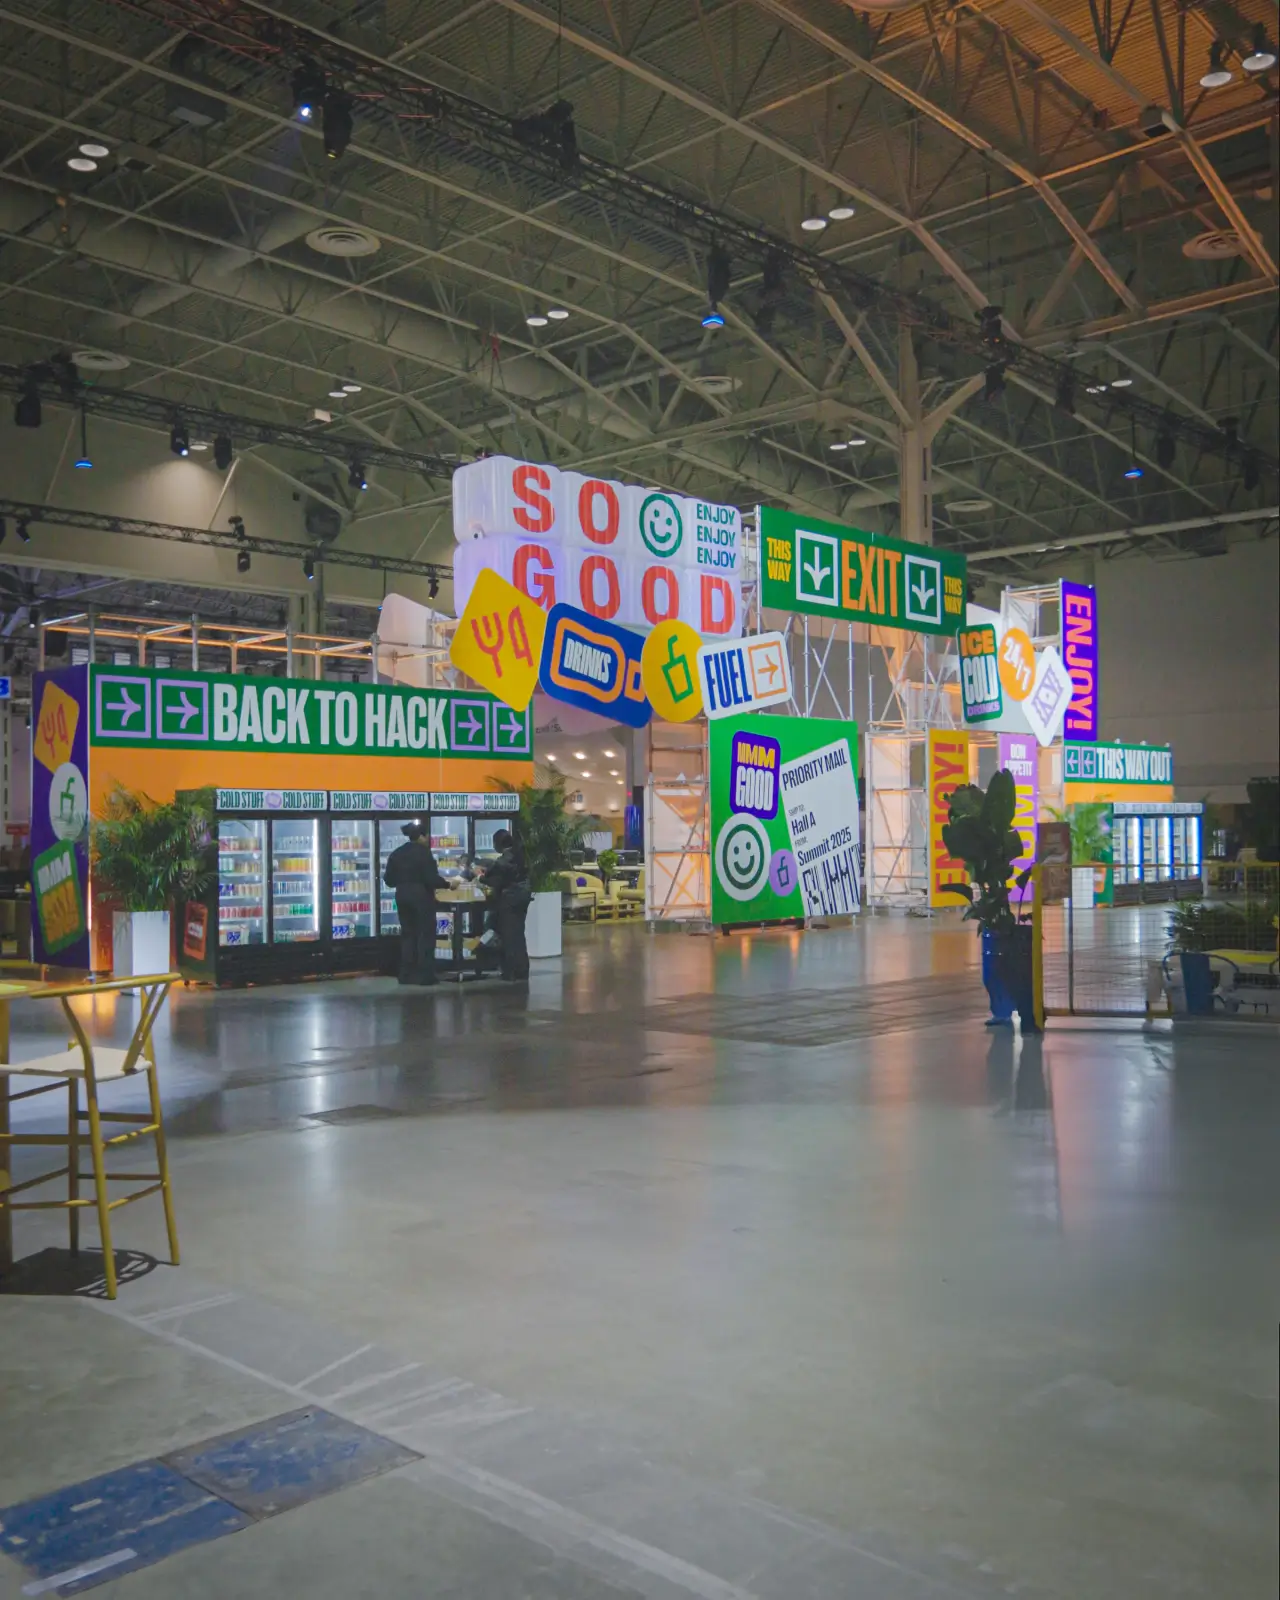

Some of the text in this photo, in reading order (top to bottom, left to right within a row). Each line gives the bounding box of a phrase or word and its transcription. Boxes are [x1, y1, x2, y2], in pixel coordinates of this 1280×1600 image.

[512, 465, 620, 545] SO
[696, 503, 736, 525] ENJOY
[696, 525, 736, 547] ENJOY
[766, 537, 792, 561] THIS
[696, 547, 736, 568] ENJOY
[767, 560, 792, 582] WAY
[512, 544, 736, 634] GOOD
[841, 540, 902, 617] EXIT
[943, 576, 963, 596] THIS
[944, 594, 962, 615] WAY
[960, 629, 995, 657] ICE
[563, 637, 612, 684] DRINKS
[1003, 636, 1032, 692] 24/7
[1065, 594, 1093, 731] ENJOY!
[703, 648, 752, 711] FUEL
[962, 654, 999, 705] COLD
[213, 683, 449, 750] BACK TO HACK
[967, 701, 1000, 717] DRINKS
[782, 747, 848, 791] PRIORITY MAIL
[1096, 747, 1172, 781] THIS WAY OUT
[220, 790, 264, 808] COLD STUFF
[282, 791, 324, 808] COLD STUFF
[333, 792, 372, 809] COLD STUFF
[388, 793, 425, 809] COLD STUFF
[735, 765, 774, 812] GOOD
[791, 811, 816, 836] Hall A
[797, 826, 852, 867] Summit 2025
